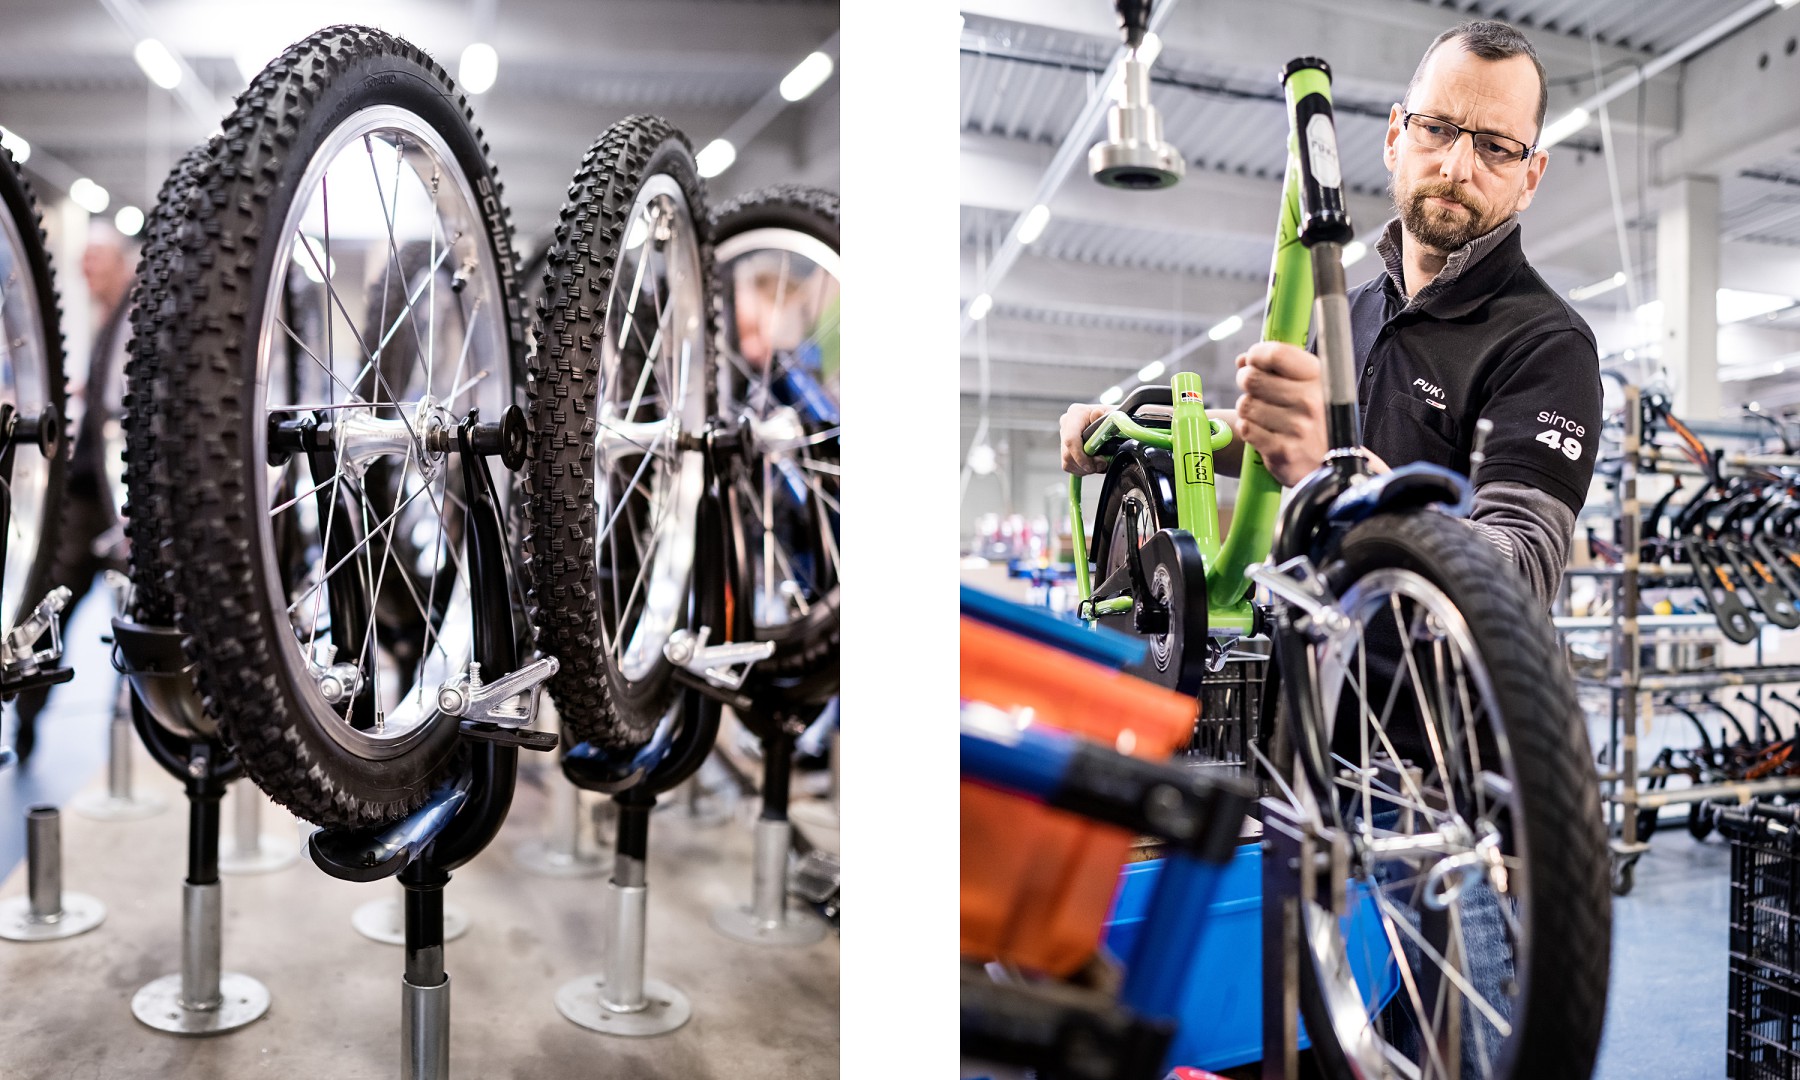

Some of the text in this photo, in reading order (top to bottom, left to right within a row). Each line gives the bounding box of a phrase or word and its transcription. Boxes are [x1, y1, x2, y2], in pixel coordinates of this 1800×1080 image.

[1536, 410, 1586, 438] since
[1535, 429, 1583, 461] 49
[1193, 455, 1208, 481] Z8
